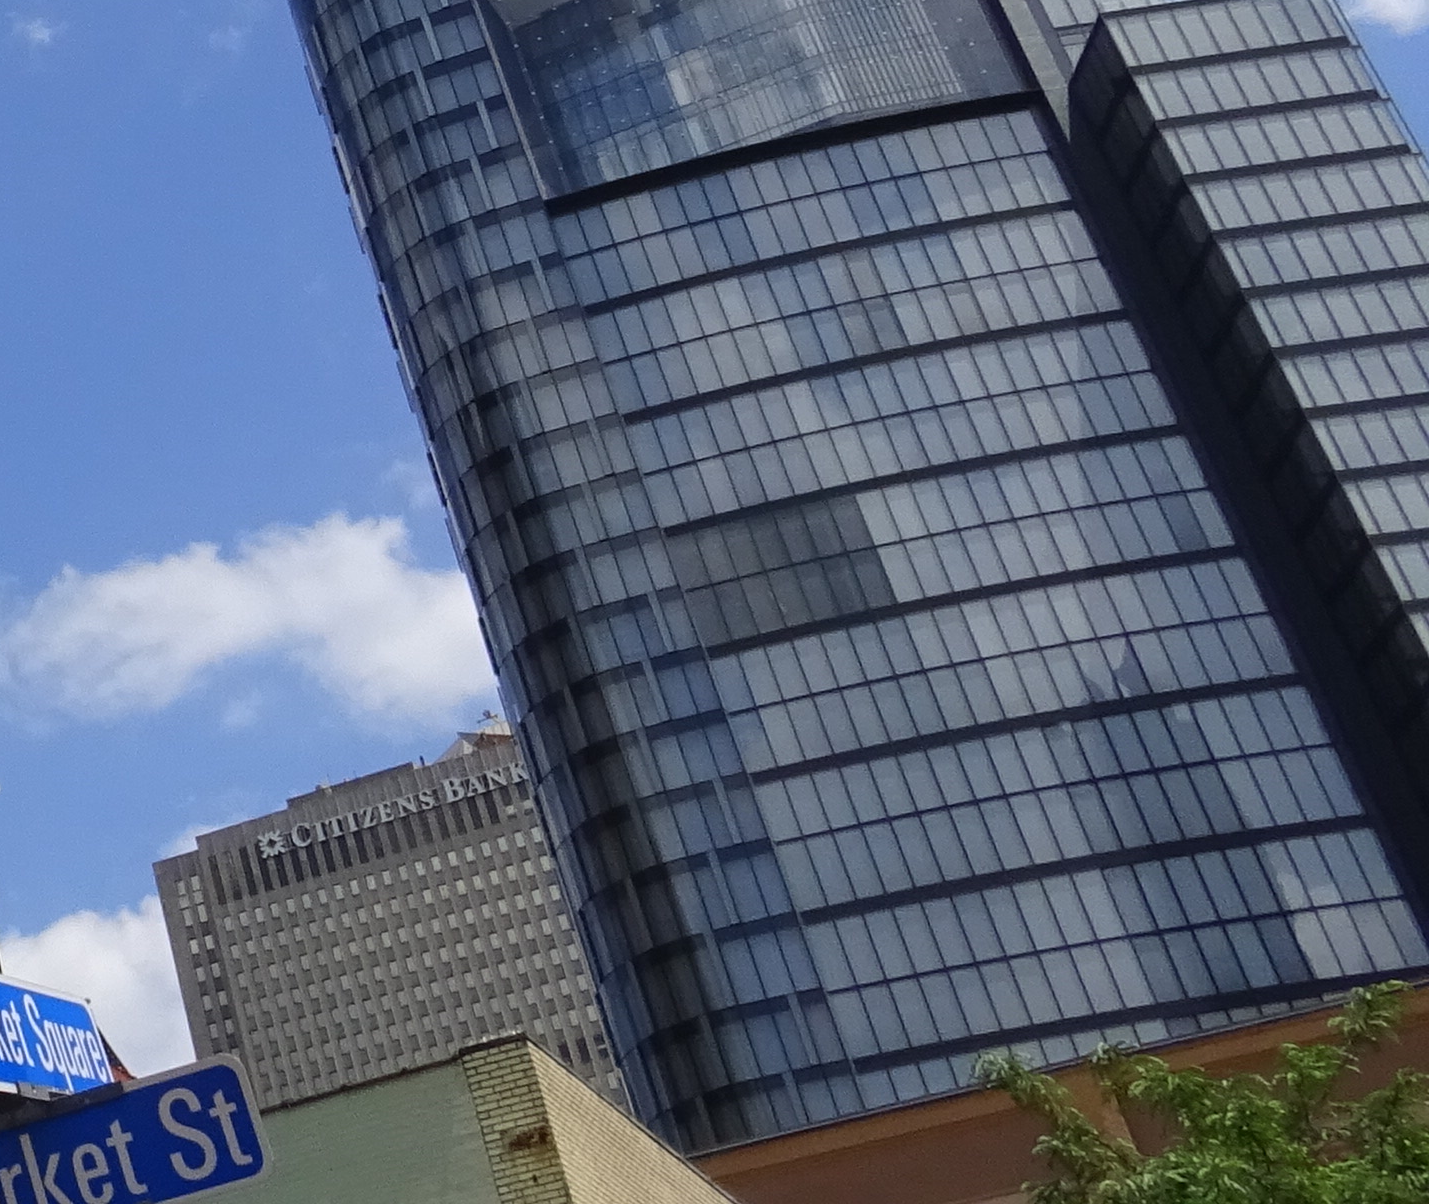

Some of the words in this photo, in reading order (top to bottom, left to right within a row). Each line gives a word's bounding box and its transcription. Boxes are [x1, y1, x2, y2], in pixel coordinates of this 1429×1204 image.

[291, 790, 435, 847] CITIZENS
[442, 762, 530, 804] BANK
[23, 993, 115, 1095] Square
[158, 1087, 253, 1182] St
